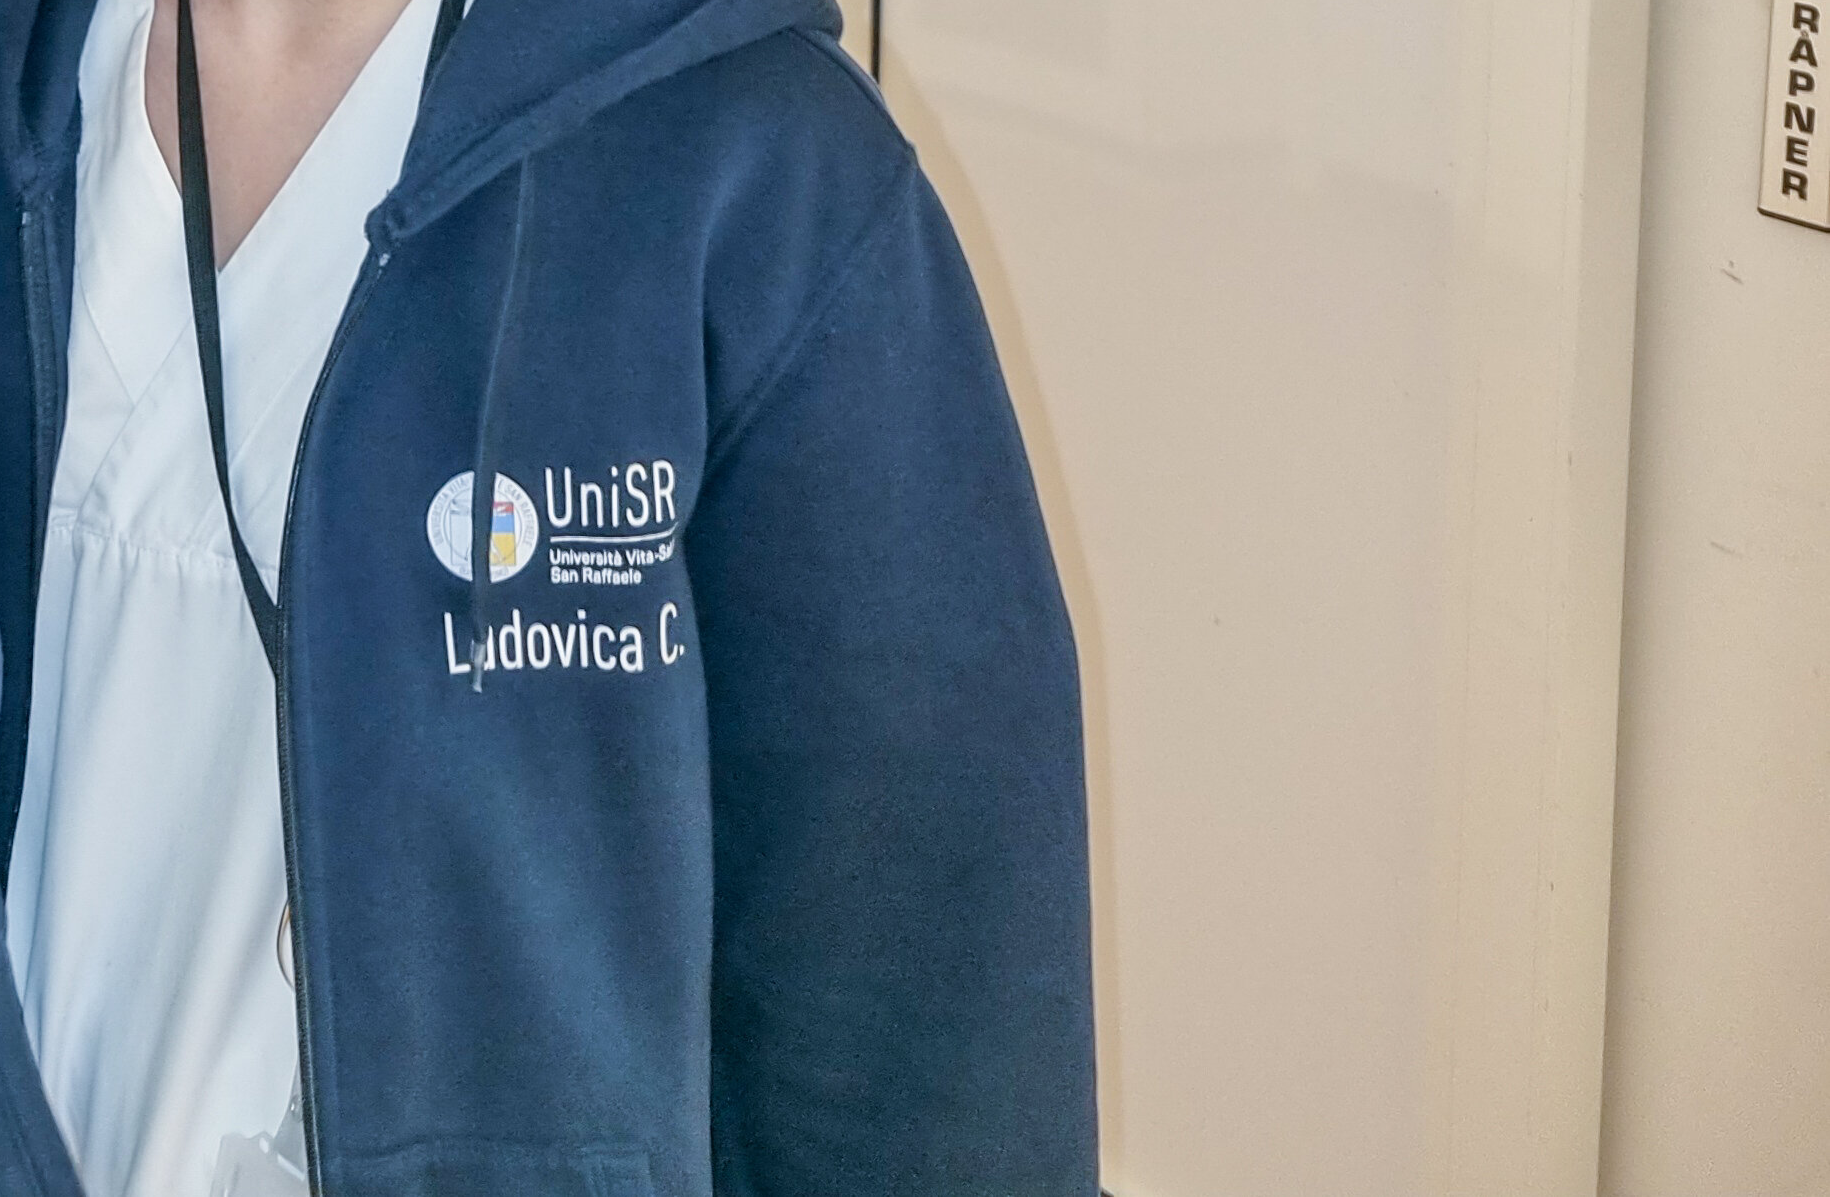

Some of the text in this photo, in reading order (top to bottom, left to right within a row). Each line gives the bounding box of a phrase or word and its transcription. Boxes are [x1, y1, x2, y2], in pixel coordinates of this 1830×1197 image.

[545, 459, 676, 528] UniSR
[550, 566, 642, 585] San Raffaele
[659, 602, 685, 666] C.
